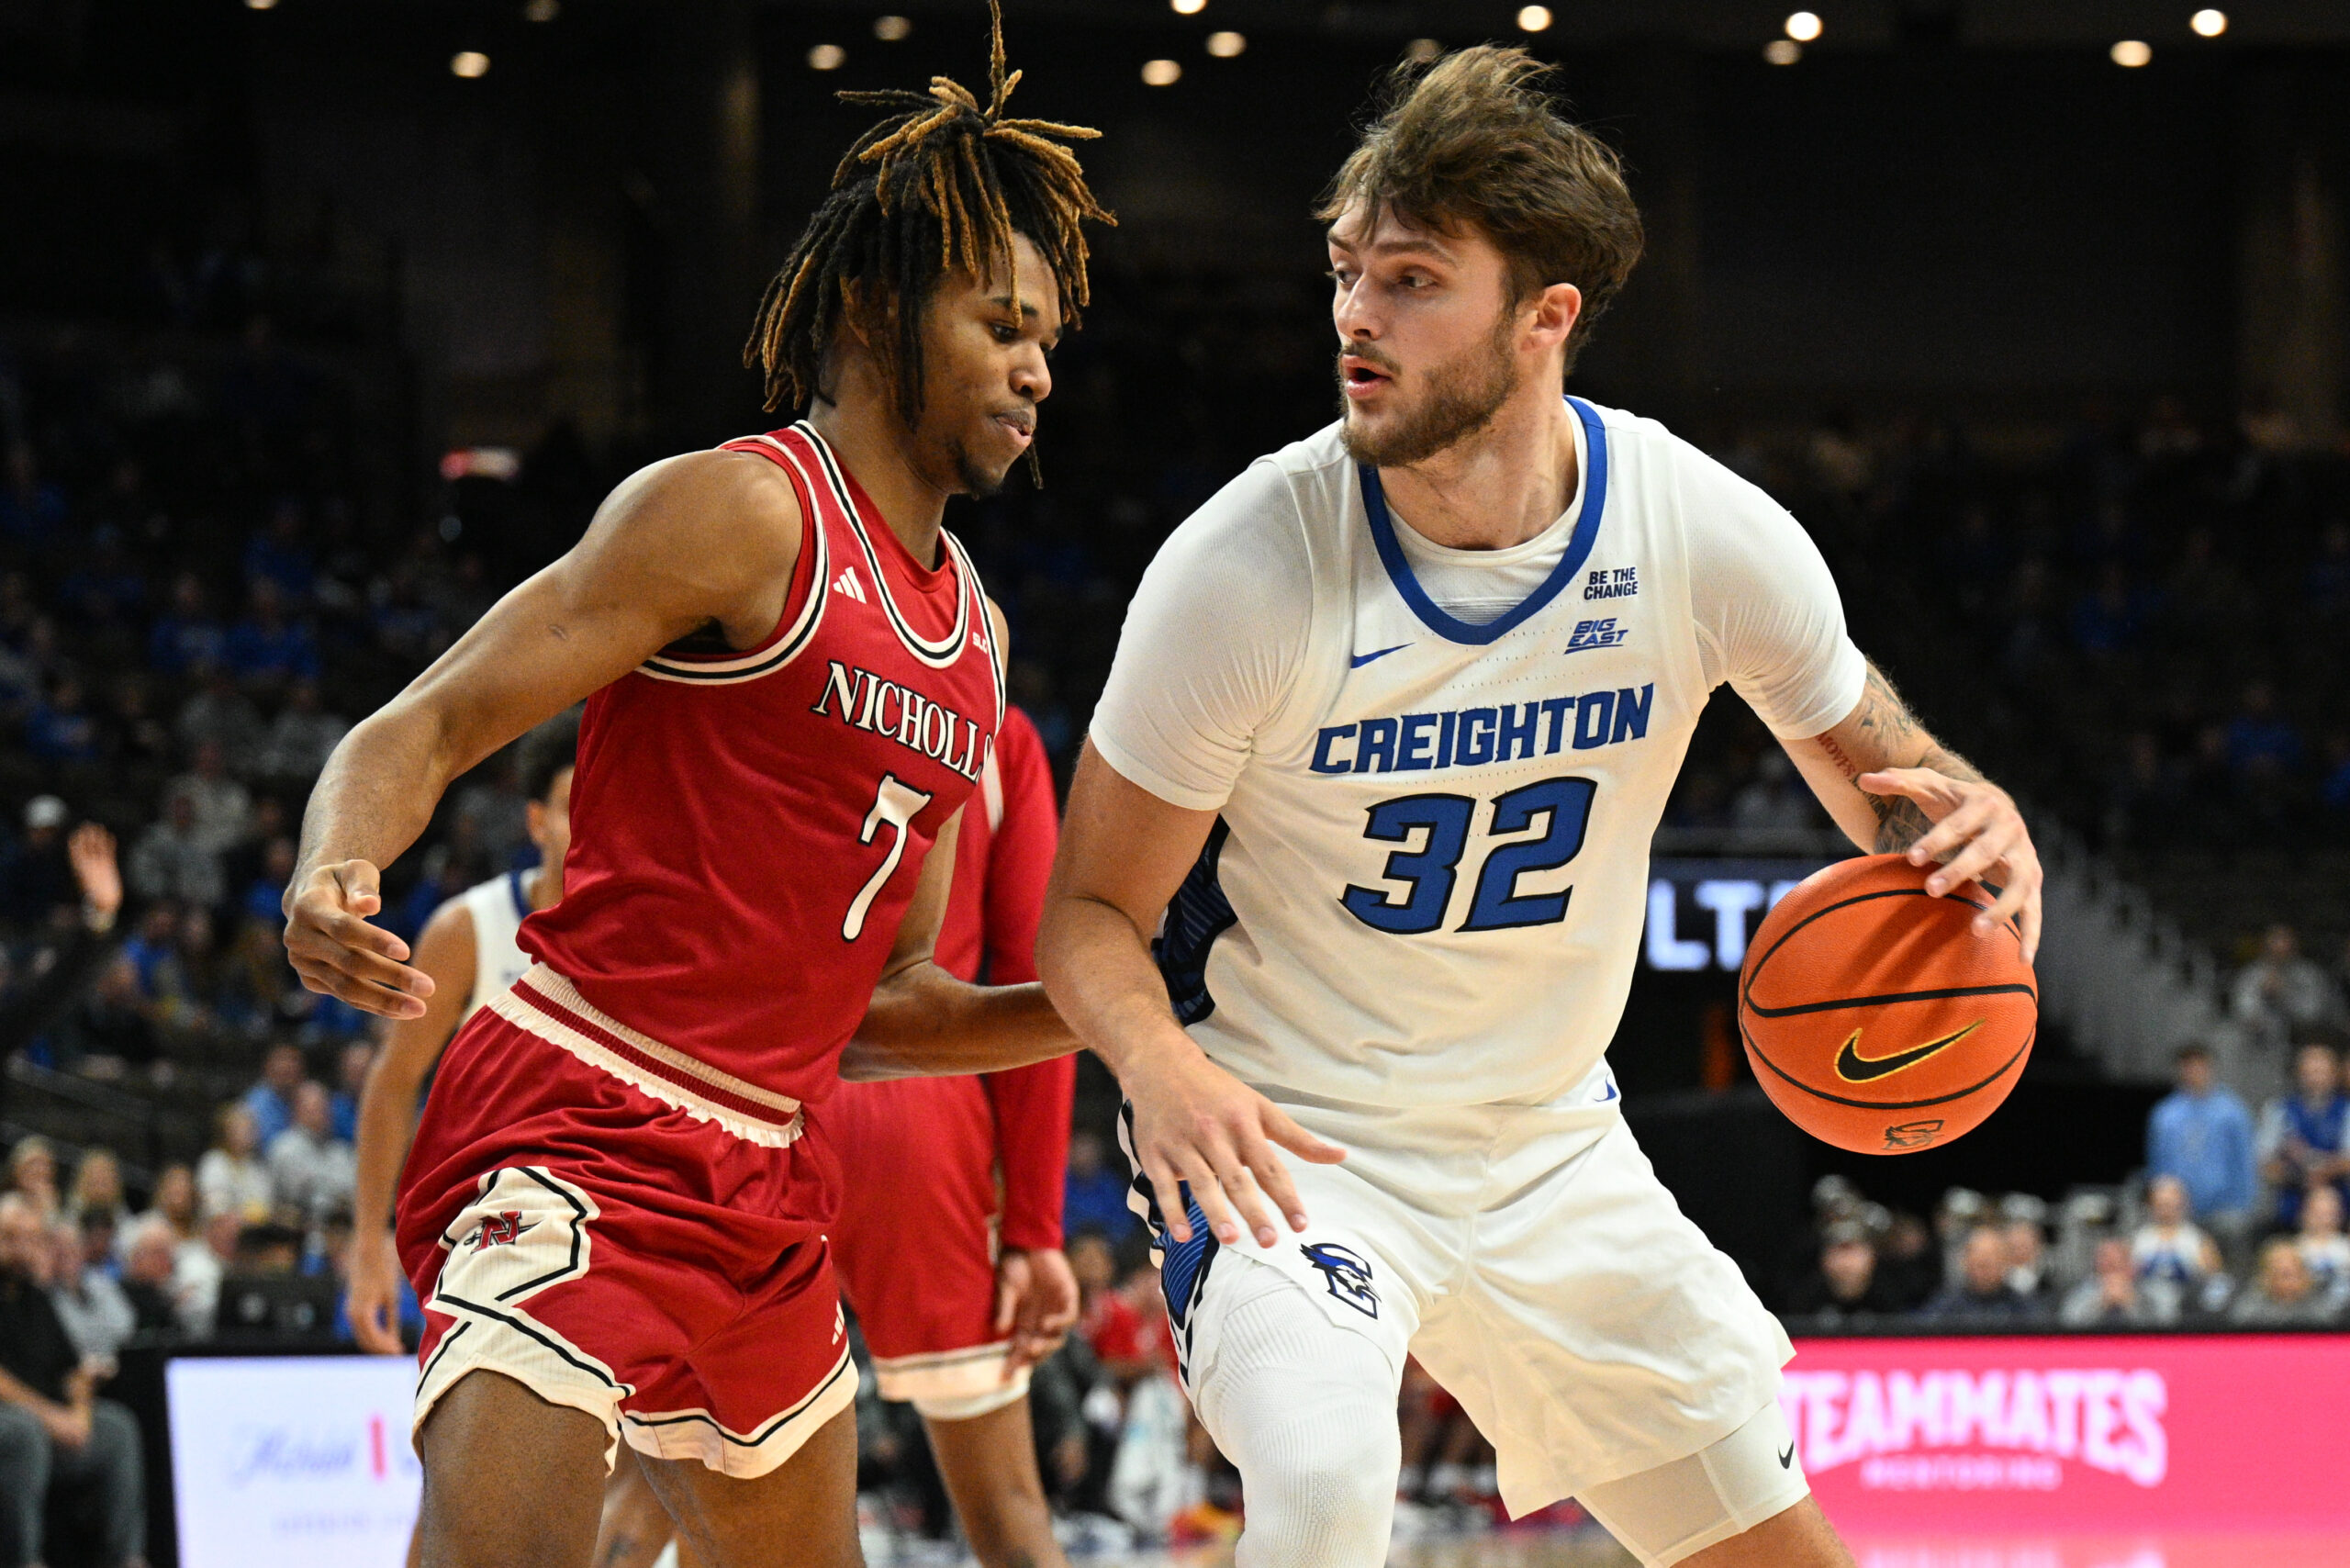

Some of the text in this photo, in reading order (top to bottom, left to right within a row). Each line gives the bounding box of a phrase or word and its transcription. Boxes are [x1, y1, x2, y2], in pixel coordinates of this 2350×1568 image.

[1583, 581, 1638, 600] CHANGE
[1588, 566, 1636, 586] BE THE
[1567, 630, 1628, 647] EAST
[1573, 618, 1617, 634] BIG
[1309, 682, 1654, 774] CREIGHTON
[842, 770, 933, 943] 7
[1337, 776, 1598, 935] 32
[1647, 879, 1803, 971] LT
